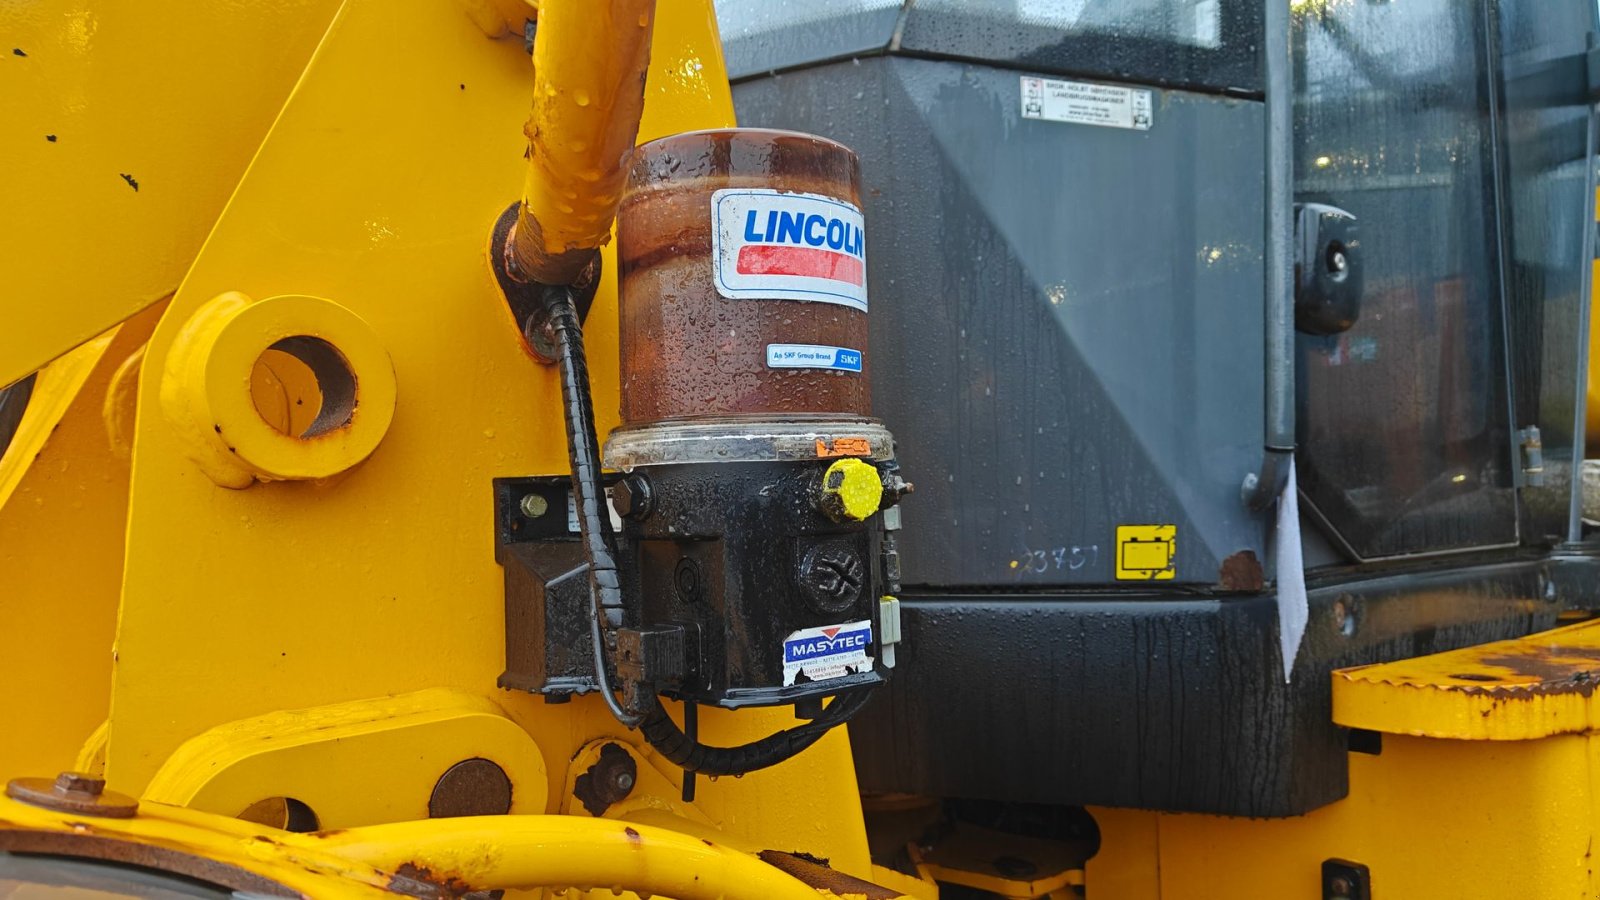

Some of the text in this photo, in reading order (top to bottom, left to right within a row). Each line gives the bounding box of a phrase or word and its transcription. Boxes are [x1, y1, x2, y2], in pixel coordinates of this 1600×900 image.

[744, 209, 863, 258] LINCOLN
[797, 352, 815, 360] Group
[815, 353, 831, 361] Brand
[840, 354, 859, 365] SKF
[792, 634, 865, 657] MASYTEC
